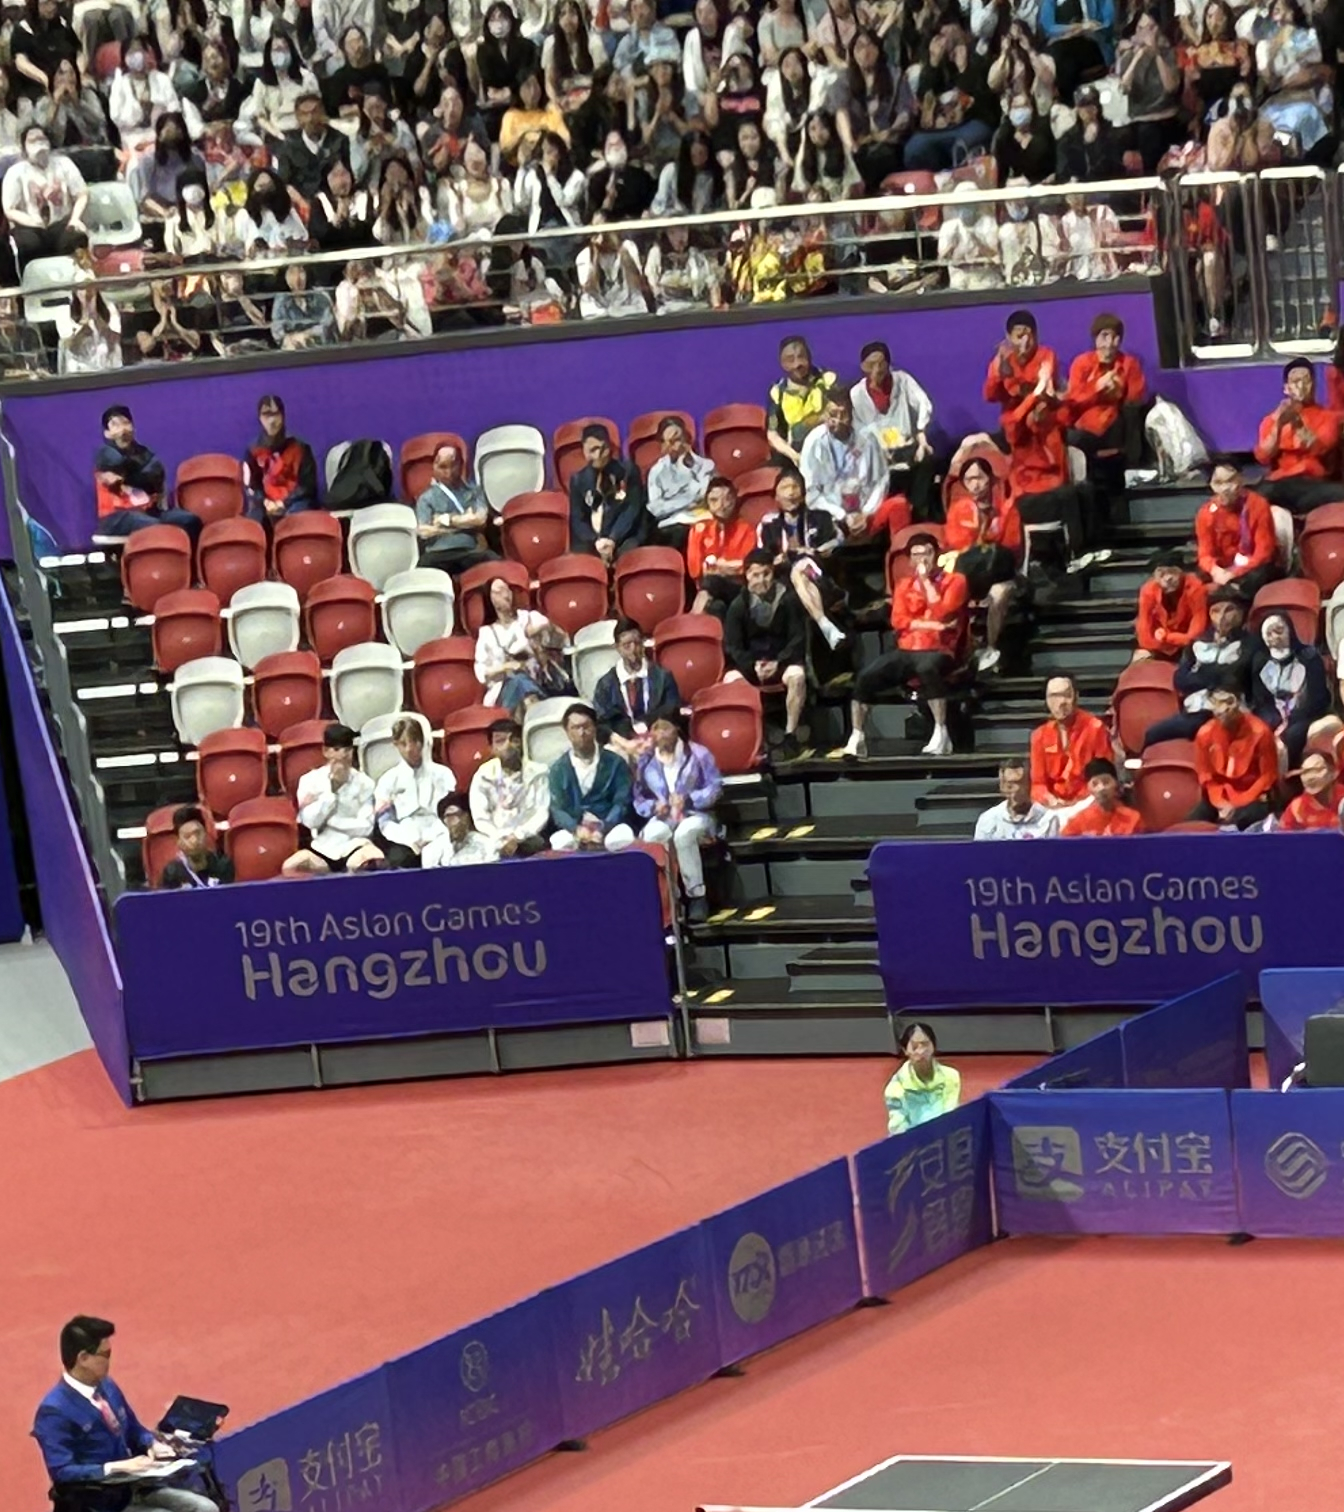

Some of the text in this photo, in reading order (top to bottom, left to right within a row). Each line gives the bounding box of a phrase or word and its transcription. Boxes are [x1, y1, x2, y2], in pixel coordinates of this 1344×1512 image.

[966, 872, 1259, 907] 19th Asian Games
[235, 901, 541, 948] 19th Asian Games
[970, 907, 1263, 966] Hangzhou
[242, 937, 548, 1000] Hangzhou
[1094, 1131, 1213, 1174] 支付宝
[297, 1421, 384, 1503] 支付宝
